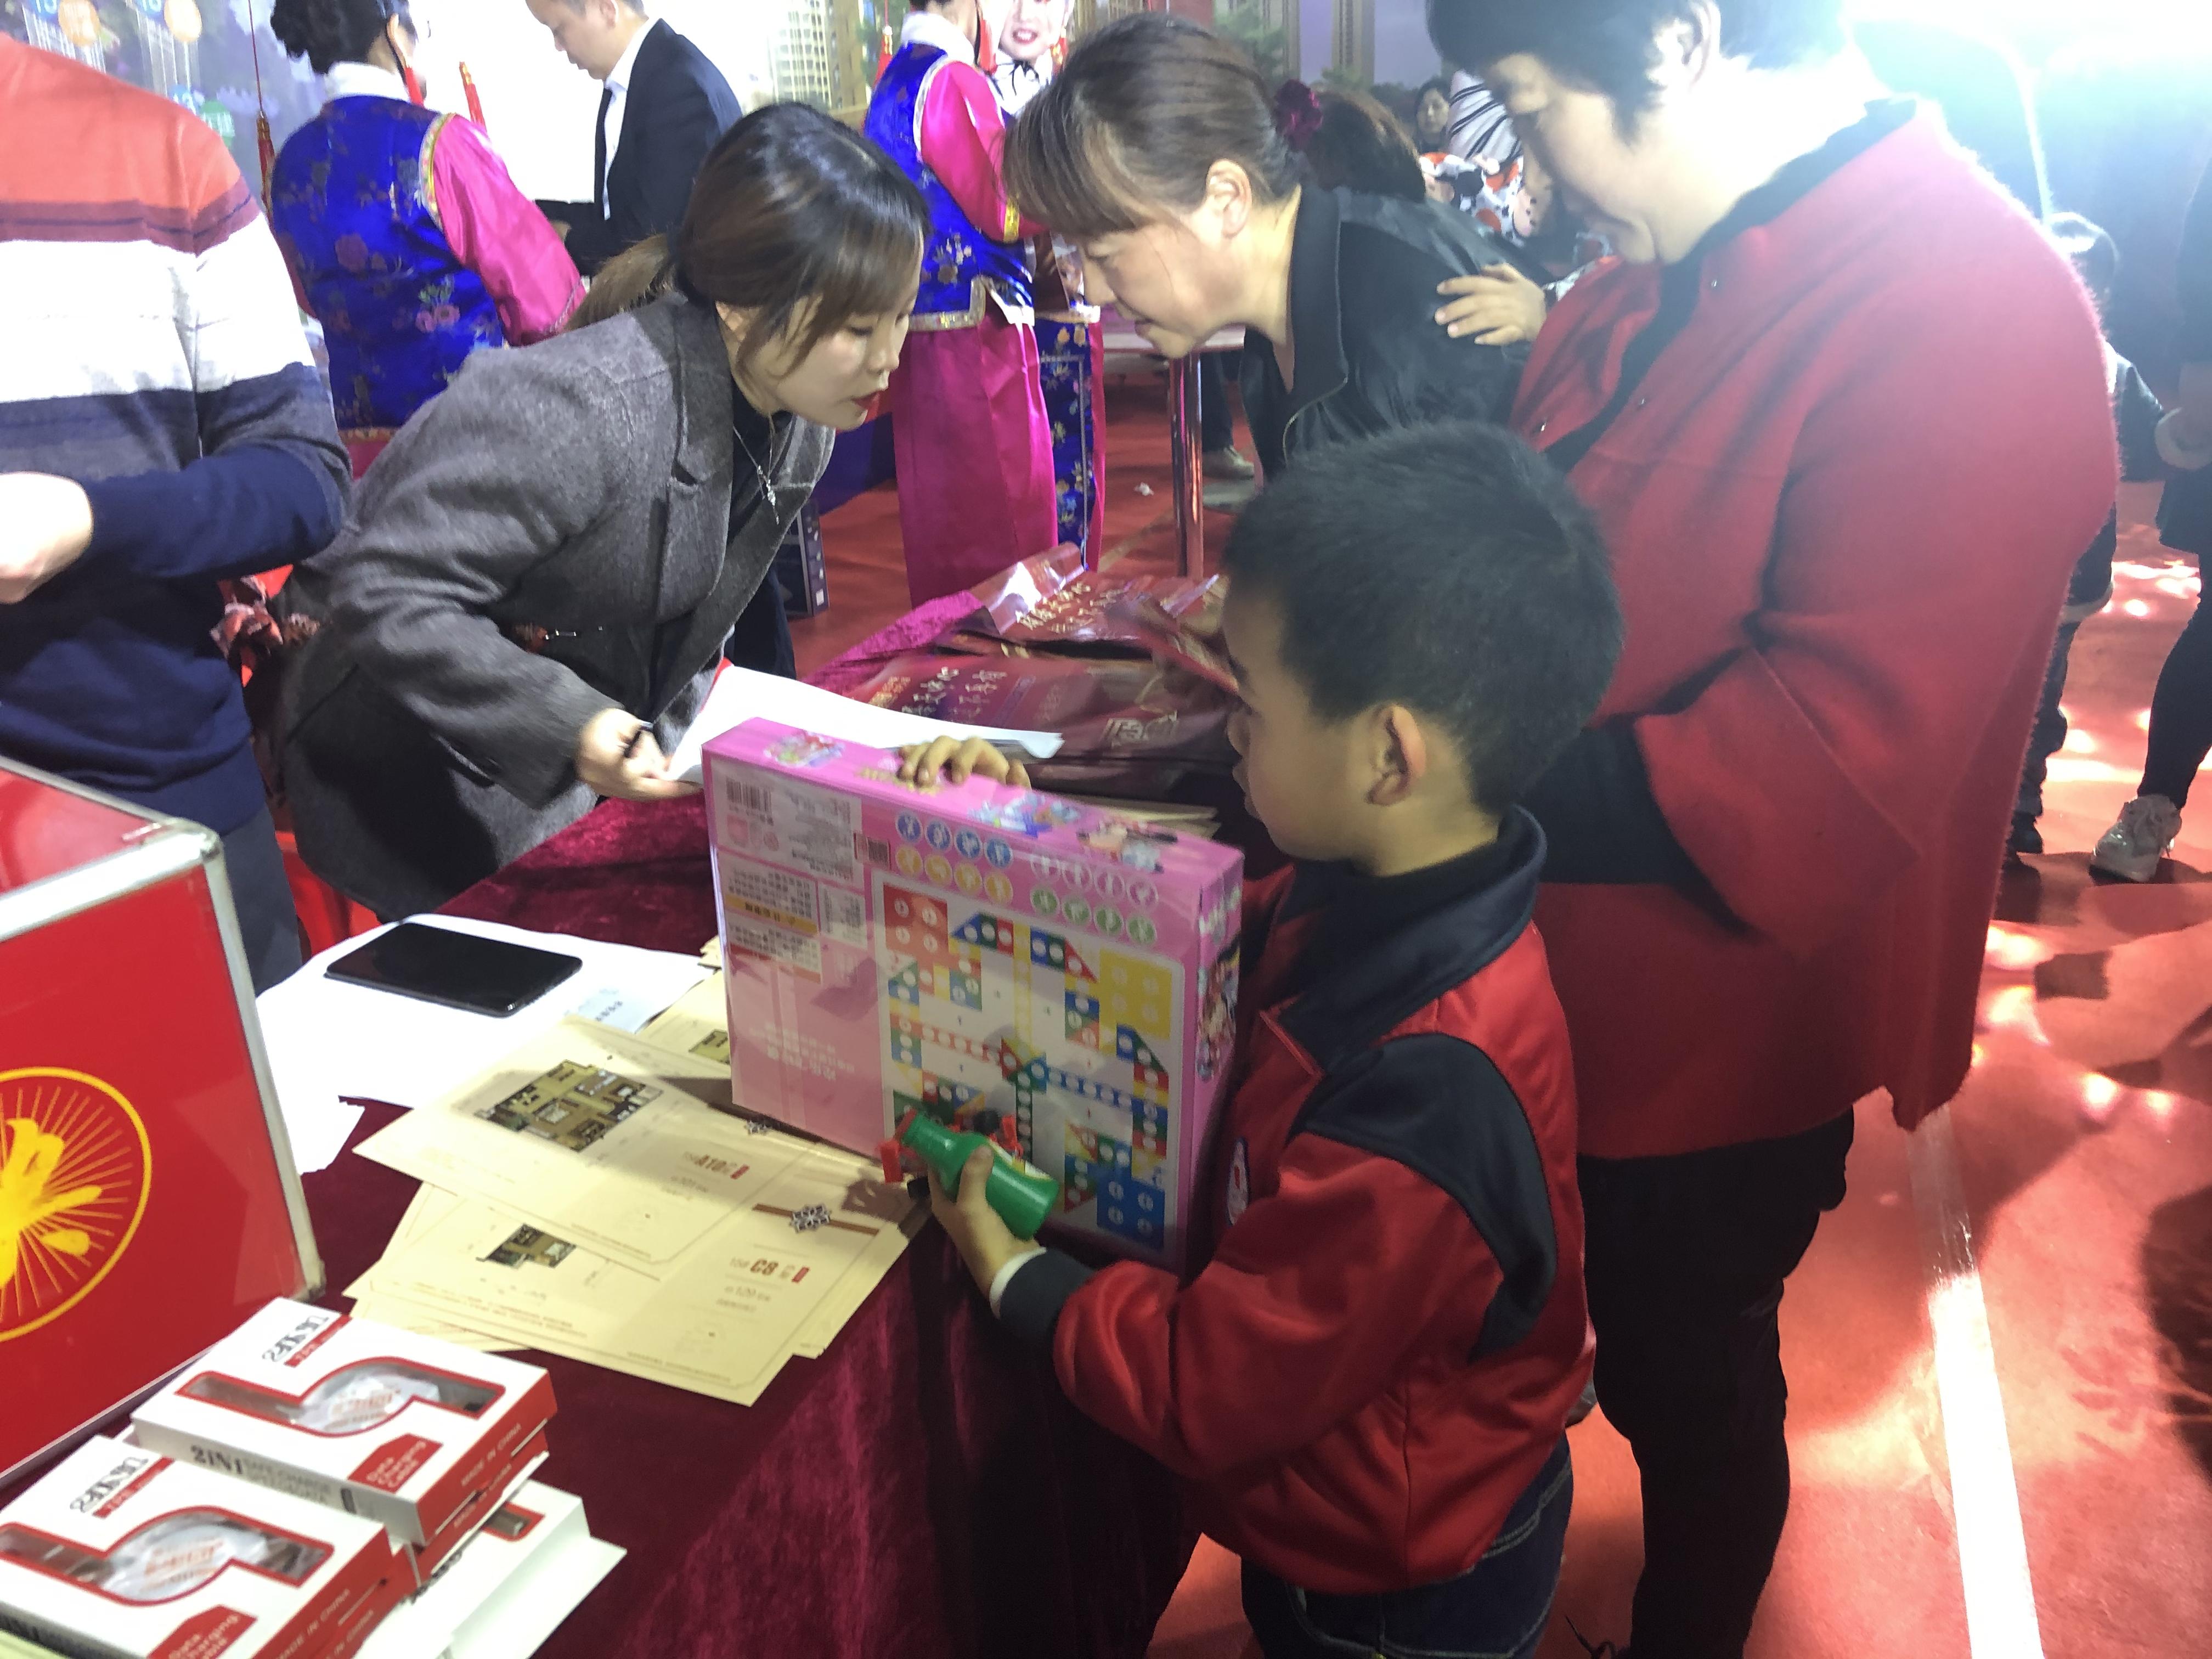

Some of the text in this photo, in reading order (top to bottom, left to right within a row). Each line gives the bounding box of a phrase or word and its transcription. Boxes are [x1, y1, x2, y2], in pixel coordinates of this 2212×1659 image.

[461, 1423, 522, 1487] MADE IN CHINA
[307, 1619, 320, 1636] IN
[320, 1588, 351, 1622] CHINA
